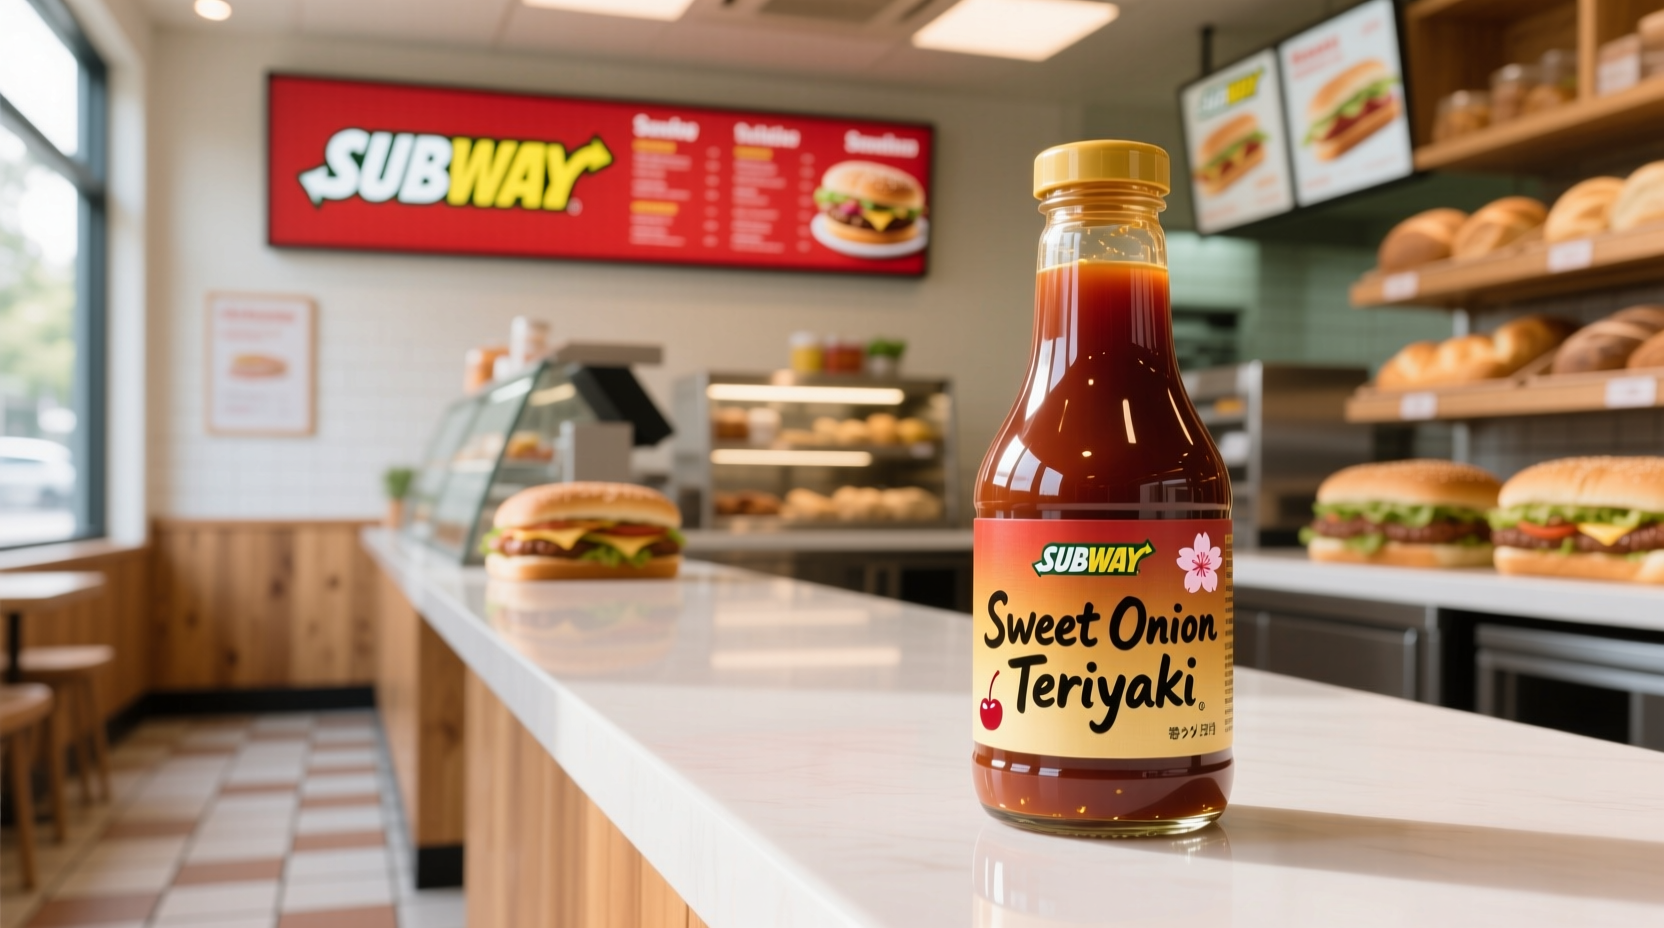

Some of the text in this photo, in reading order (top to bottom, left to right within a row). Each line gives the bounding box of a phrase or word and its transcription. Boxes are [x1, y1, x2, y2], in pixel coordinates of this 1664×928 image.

[299, 128, 612, 211] SUBWAY
[1034, 543, 1152, 573] SUBWAY
[984, 590, 1217, 650] Sweet Onion
[1008, 653, 1197, 734] Teriyaki
